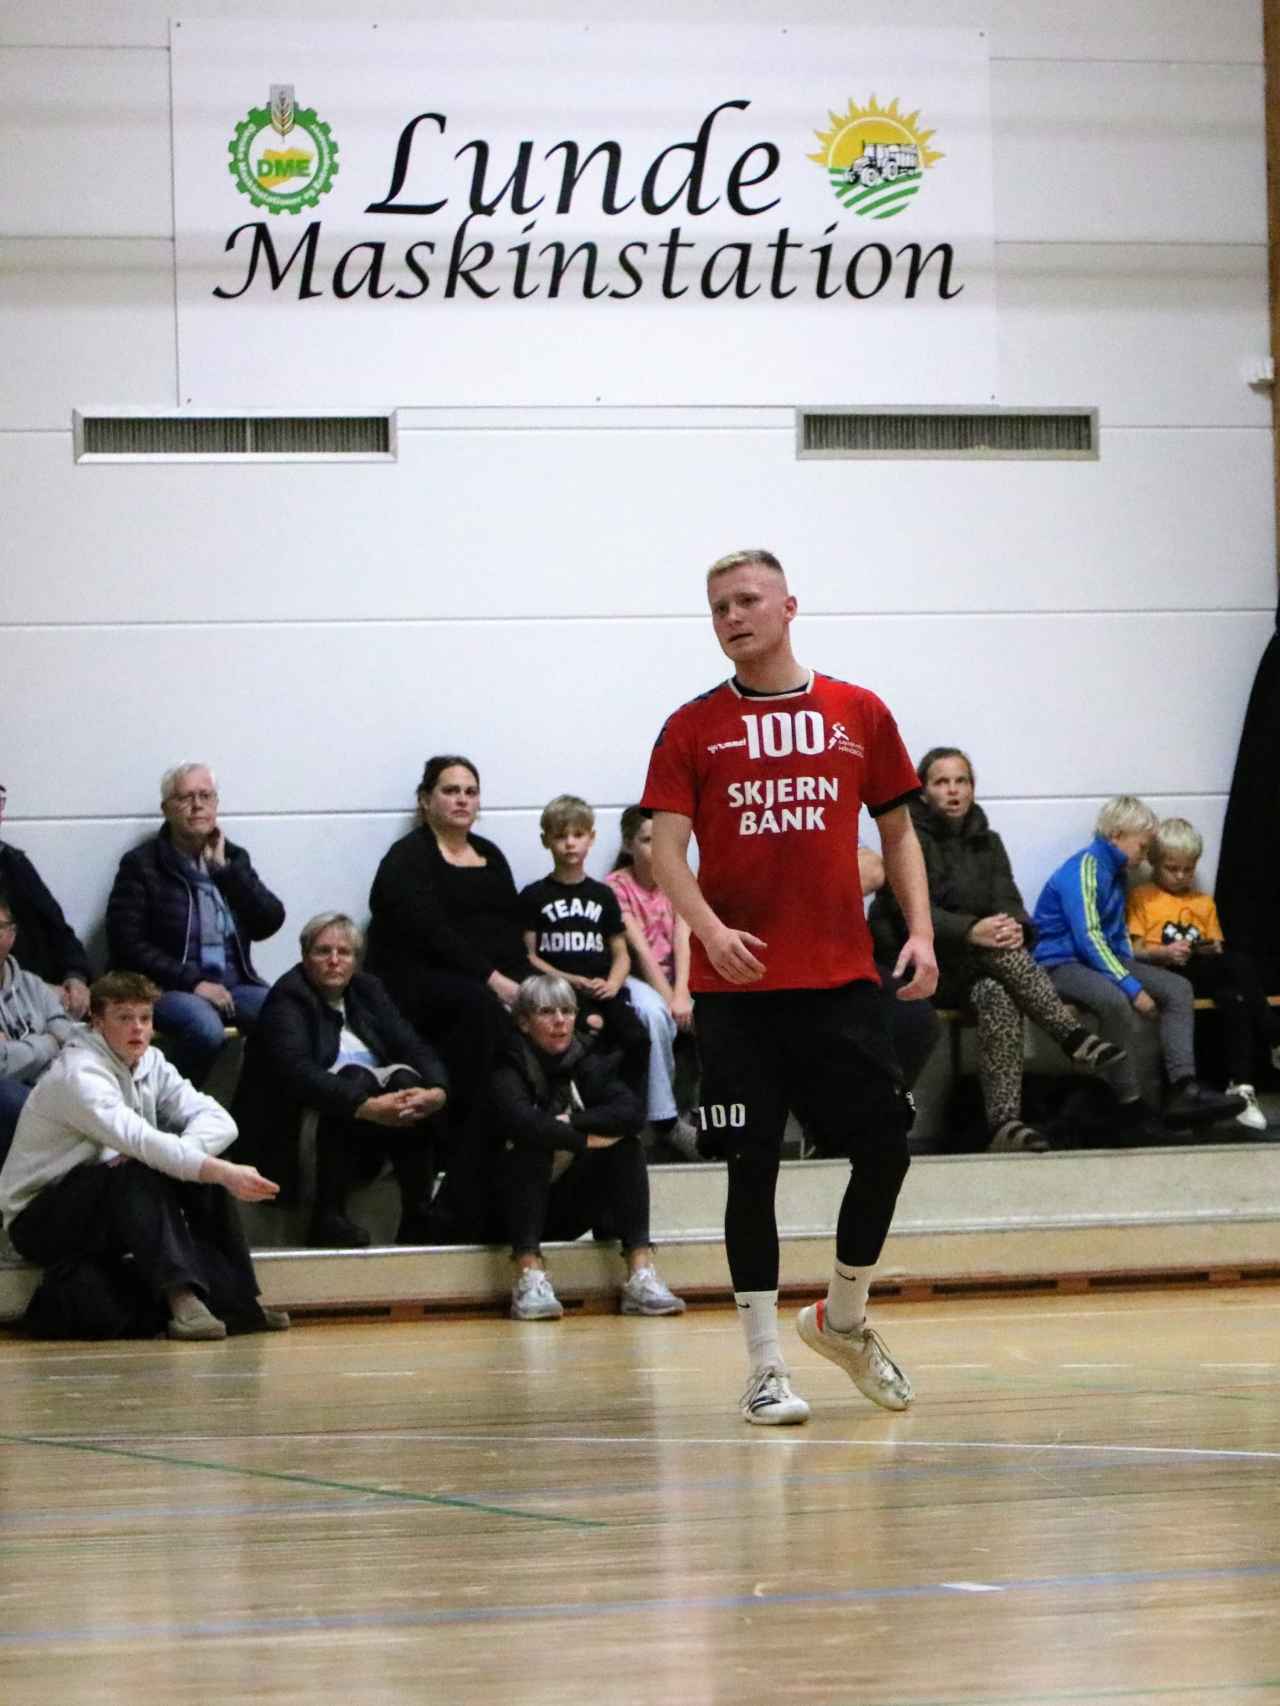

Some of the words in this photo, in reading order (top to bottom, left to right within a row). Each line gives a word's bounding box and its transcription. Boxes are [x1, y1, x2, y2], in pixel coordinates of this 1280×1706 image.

[257, 159, 311, 177] DME
[364, 100, 782, 216] Lunde
[212, 212, 965, 300] Maskinstation
[741, 710, 825, 760] 100
[727, 776, 839, 808] SKJERN
[739, 806, 827, 836] BANK
[541, 897, 603, 922] TEAM
[539, 931, 604, 952] ADIDAS
[698, 1103, 746, 1131] 100
